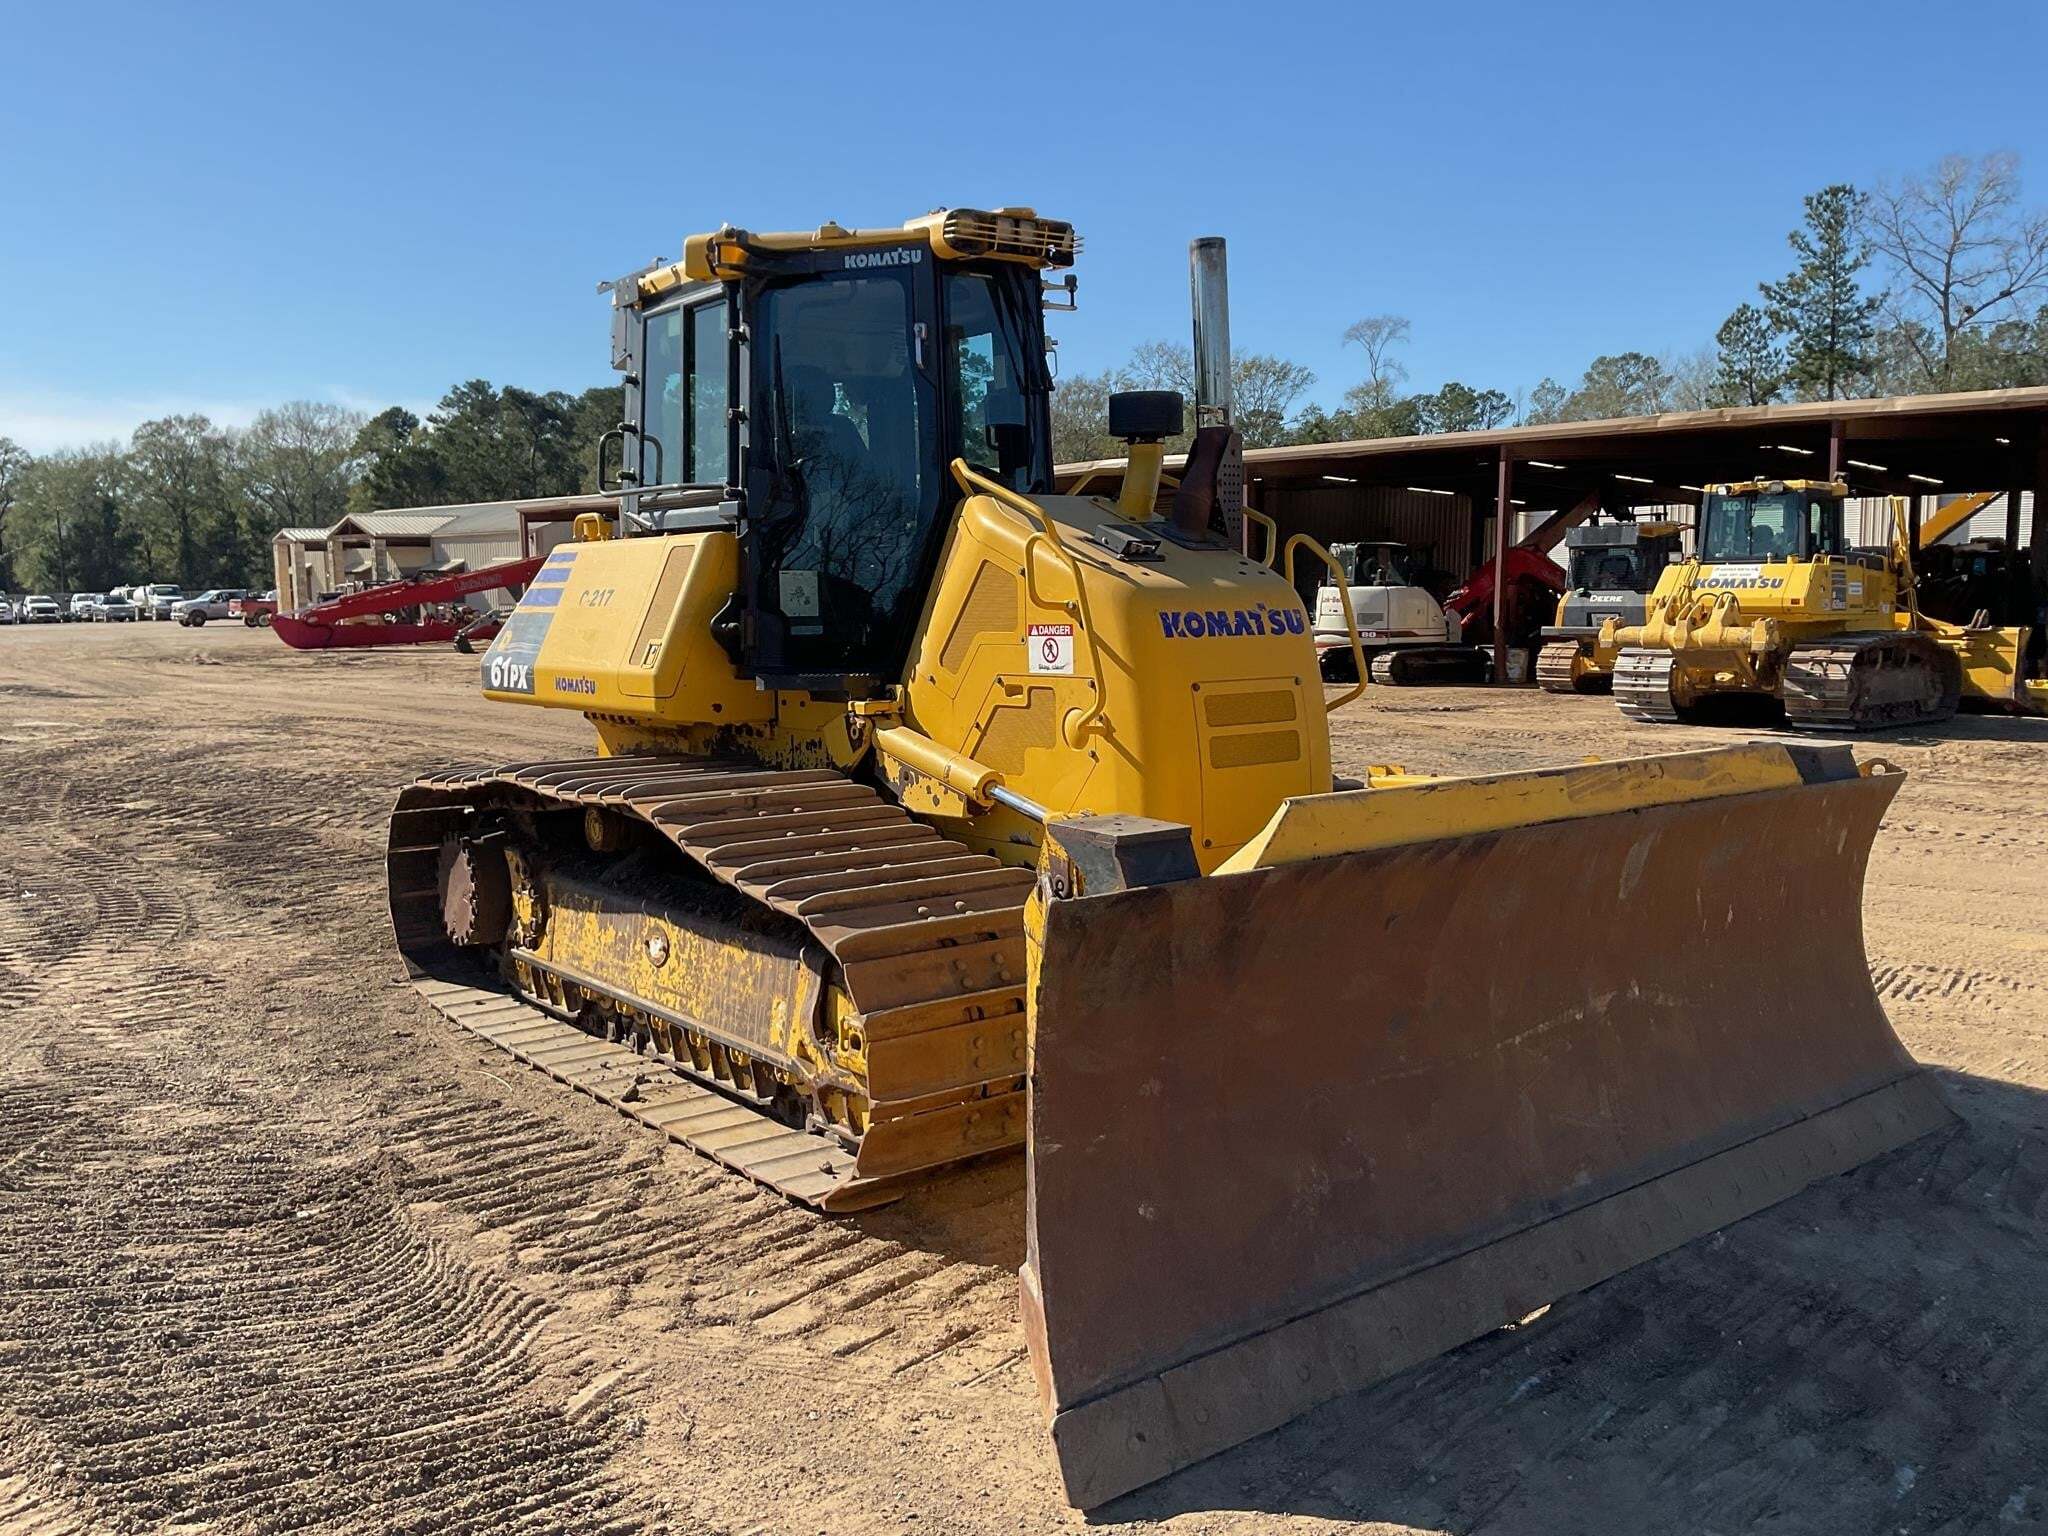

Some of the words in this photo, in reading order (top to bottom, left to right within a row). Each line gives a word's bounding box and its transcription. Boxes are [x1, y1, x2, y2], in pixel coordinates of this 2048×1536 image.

[844, 247, 921, 268] KOMATSU
[1694, 575, 1784, 589] KOMATSU
[1039, 625, 1071, 635] DANGER
[1159, 603, 1305, 638] KOMATSU
[490, 656, 527, 689] 61PX
[555, 676, 596, 694] KOMATSU
